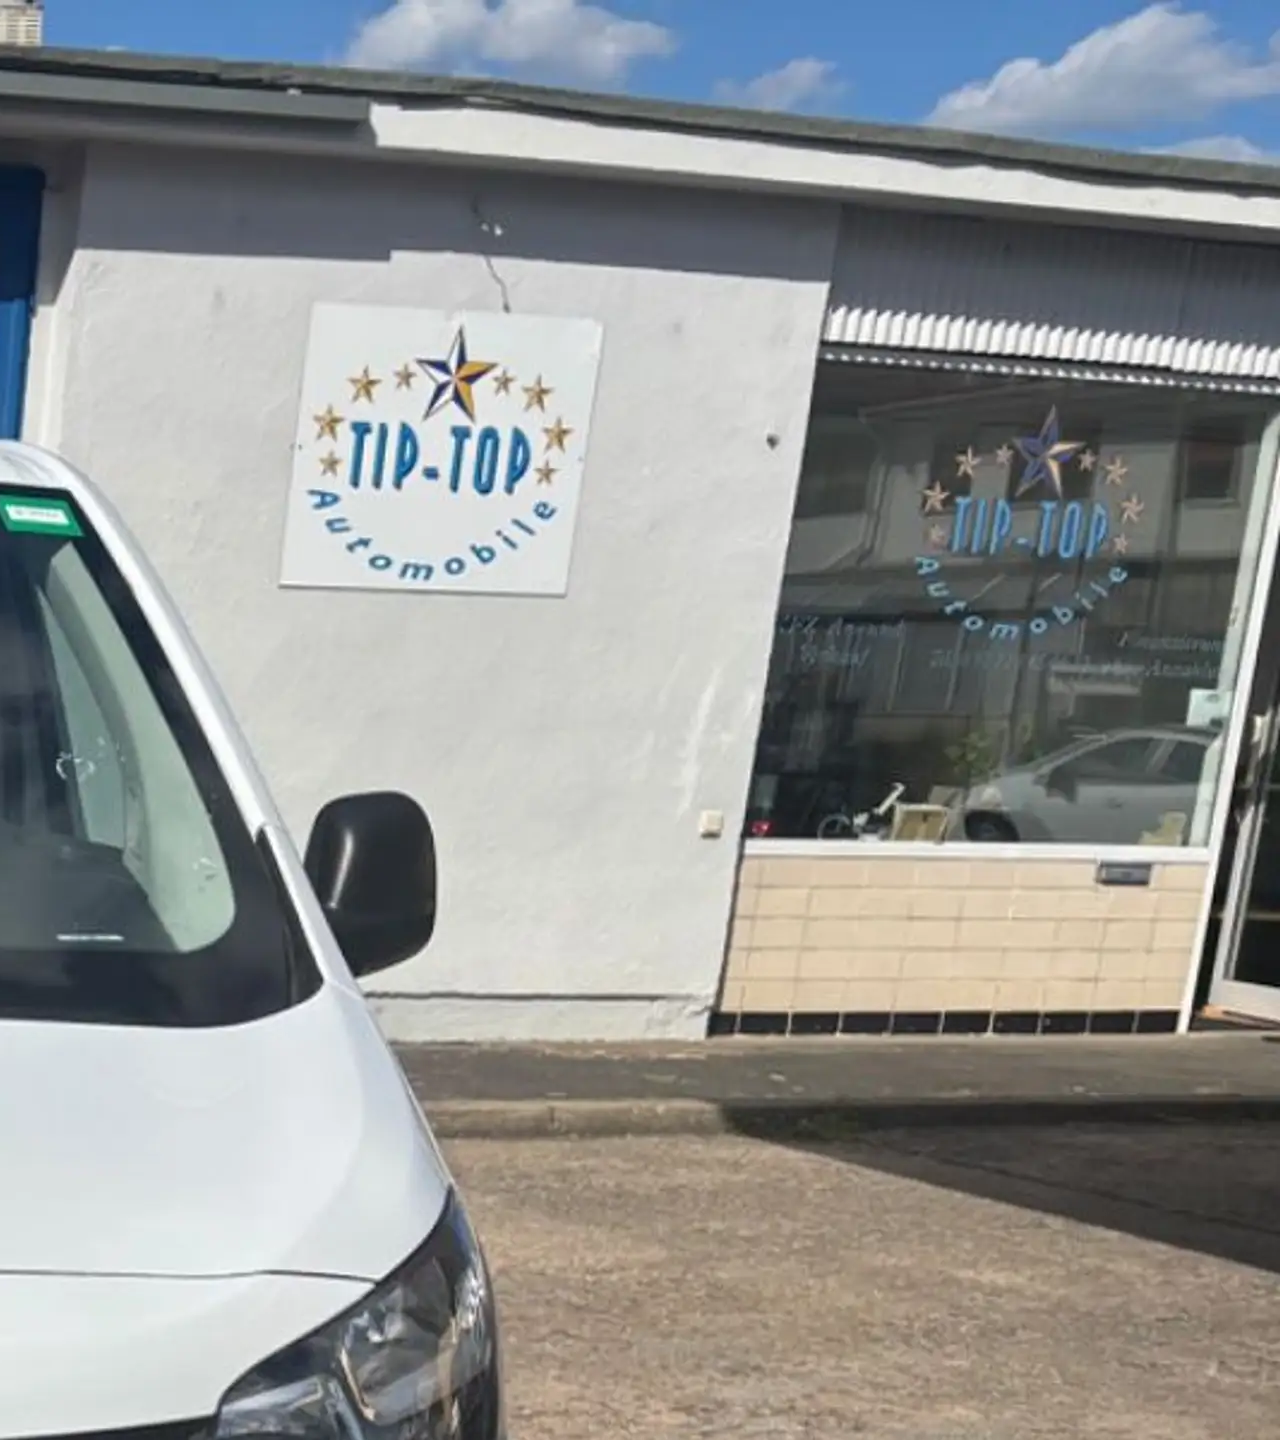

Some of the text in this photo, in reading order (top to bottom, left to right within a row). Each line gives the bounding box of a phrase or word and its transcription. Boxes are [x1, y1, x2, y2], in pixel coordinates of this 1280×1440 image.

[348, 420, 532, 496] TIP-TOP
[306, 488, 556, 581] Automobile
[950, 496, 1110, 560] TIP-TOP
[914, 556, 1128, 639] Automobile
